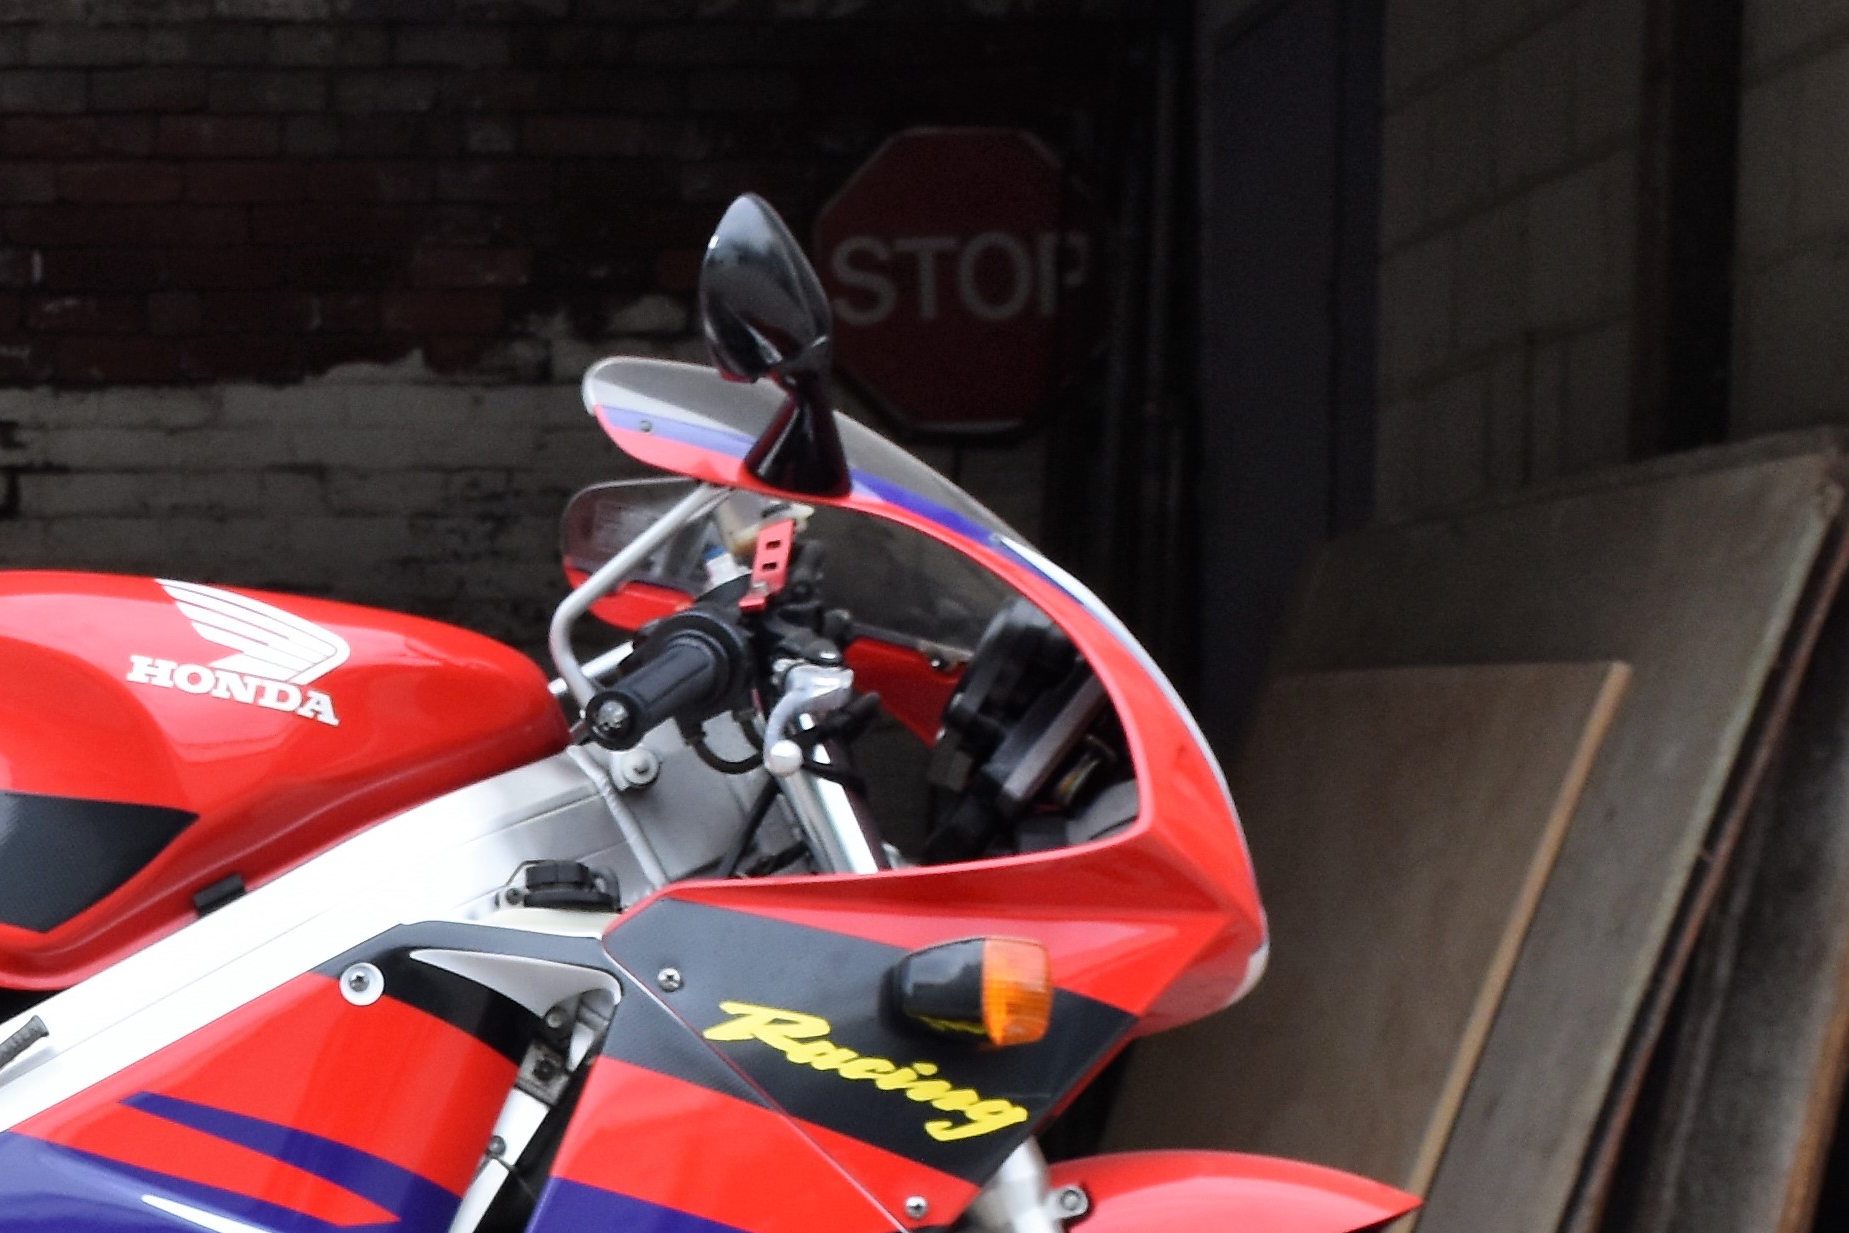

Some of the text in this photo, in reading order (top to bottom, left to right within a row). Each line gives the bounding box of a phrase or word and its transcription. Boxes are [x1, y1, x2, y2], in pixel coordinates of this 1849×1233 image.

[831, 230, 1090, 326] STOP
[126, 654, 339, 726] HONDA
[703, 1000, 1028, 1142] Racing
